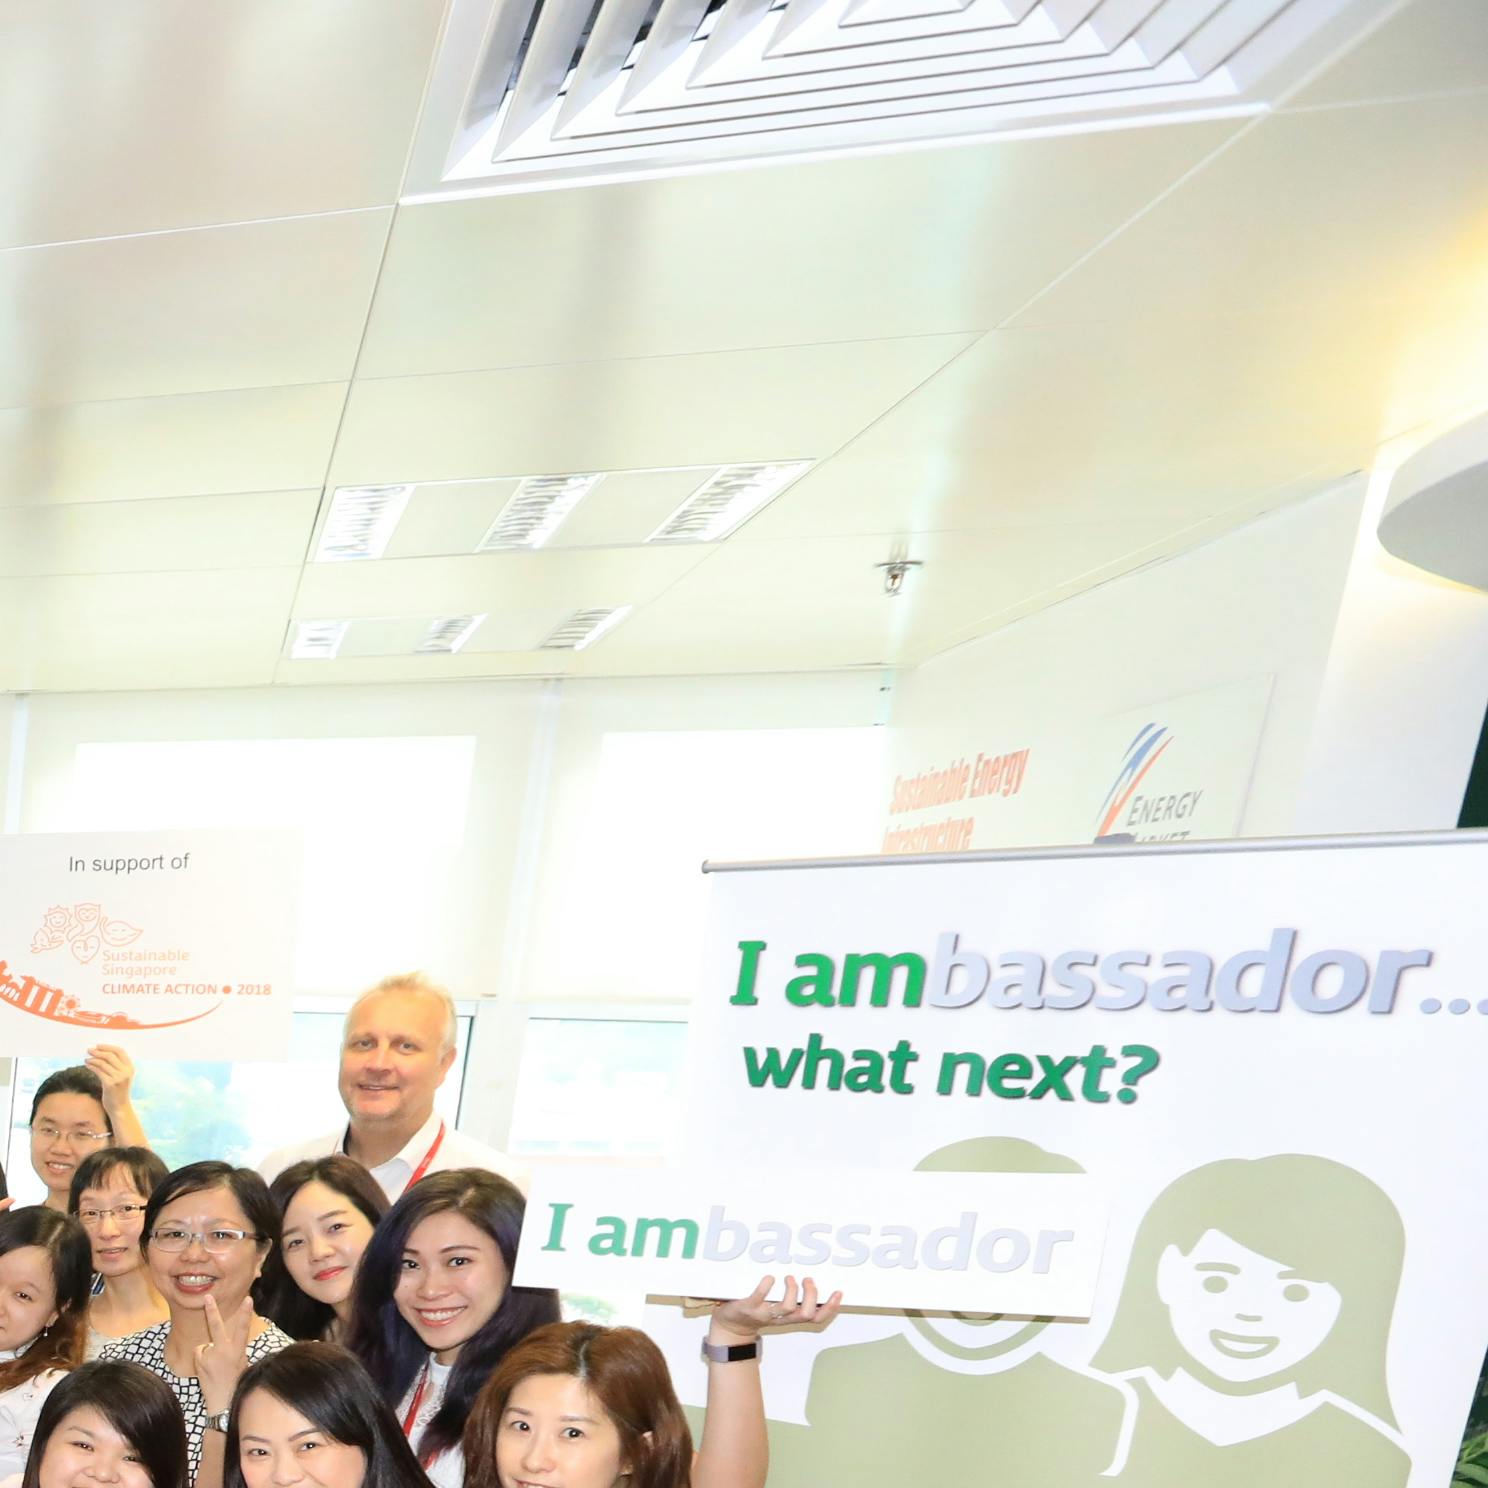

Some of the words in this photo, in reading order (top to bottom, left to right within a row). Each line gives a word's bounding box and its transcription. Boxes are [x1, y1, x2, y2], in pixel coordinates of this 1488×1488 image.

[889, 757, 971, 816] Sustainable
[970, 748, 1030, 797] Energy
[69, 856, 85, 872] In
[92, 855, 164, 874] support
[171, 853, 190, 870] of
[102, 949, 190, 962] Sustainable
[102, 964, 177, 979] Singapore
[729, 940, 767, 1006] I
[102, 983, 160, 994] CLIMATE
[164, 983, 218, 994] ACTION
[236, 984, 272, 995] 2018
[743, 1033, 920, 1095] what
[936, 1043, 1161, 1105] next?
[540, 1202, 574, 1253] I
[587, 1204, 1075, 1275] ambassador
